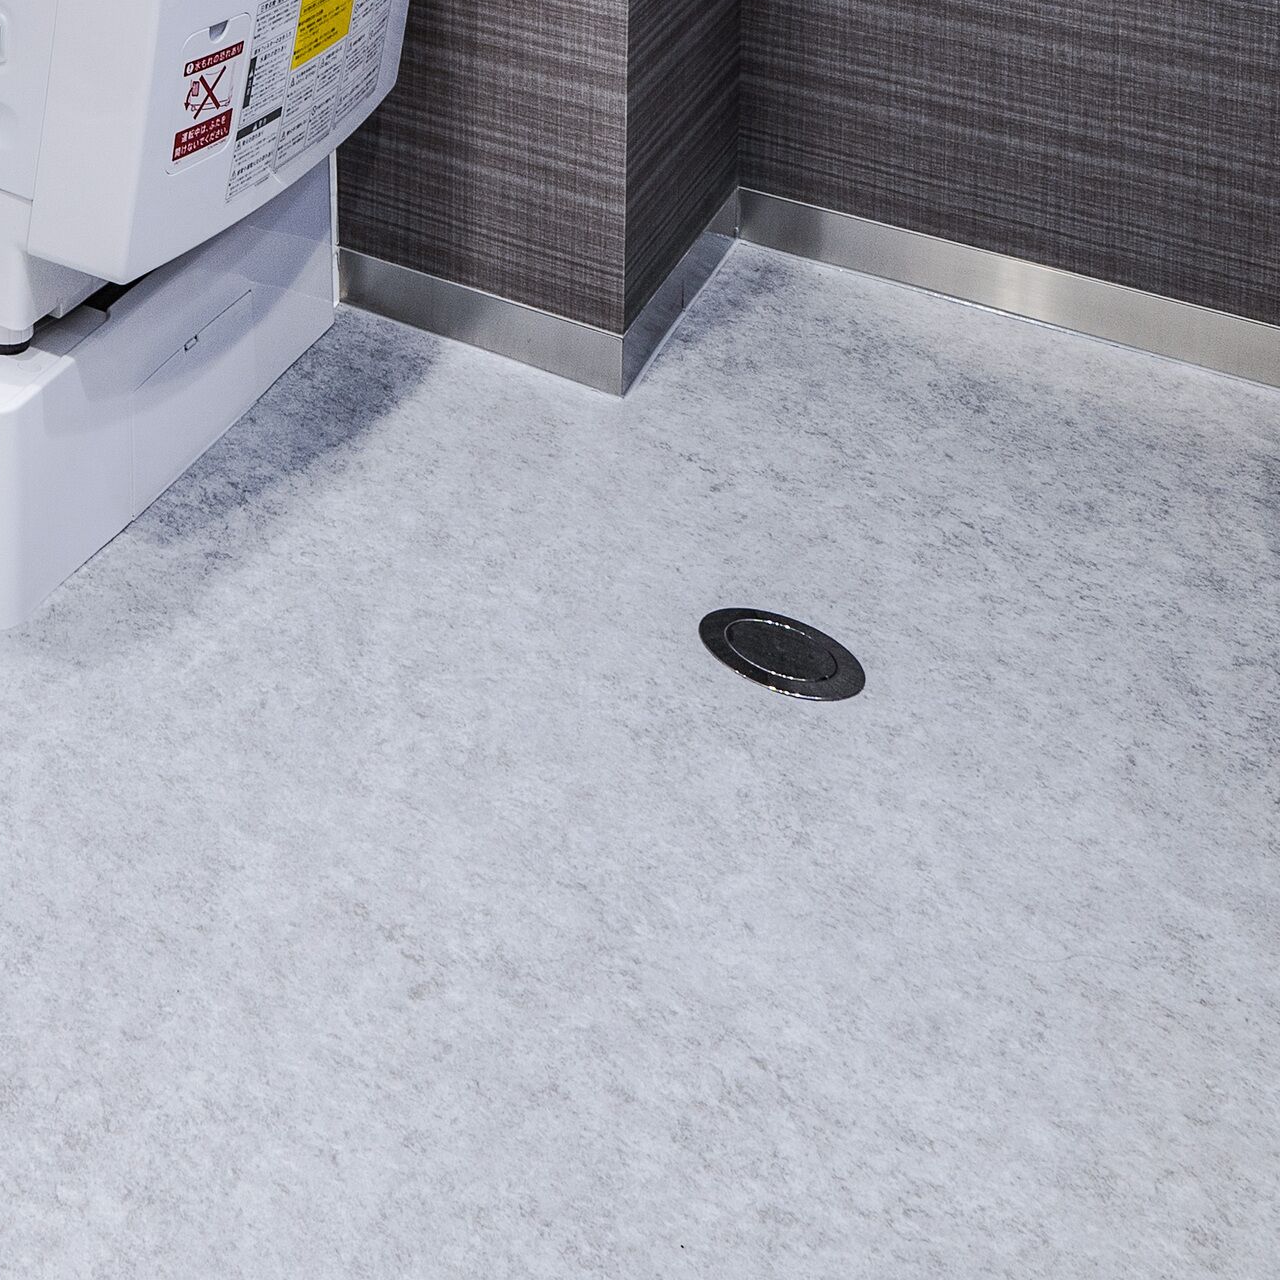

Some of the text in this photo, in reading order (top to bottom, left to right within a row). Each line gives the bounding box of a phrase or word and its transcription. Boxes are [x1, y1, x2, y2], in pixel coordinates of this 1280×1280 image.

[194, 44, 242, 71] 水もれの恐れあり
